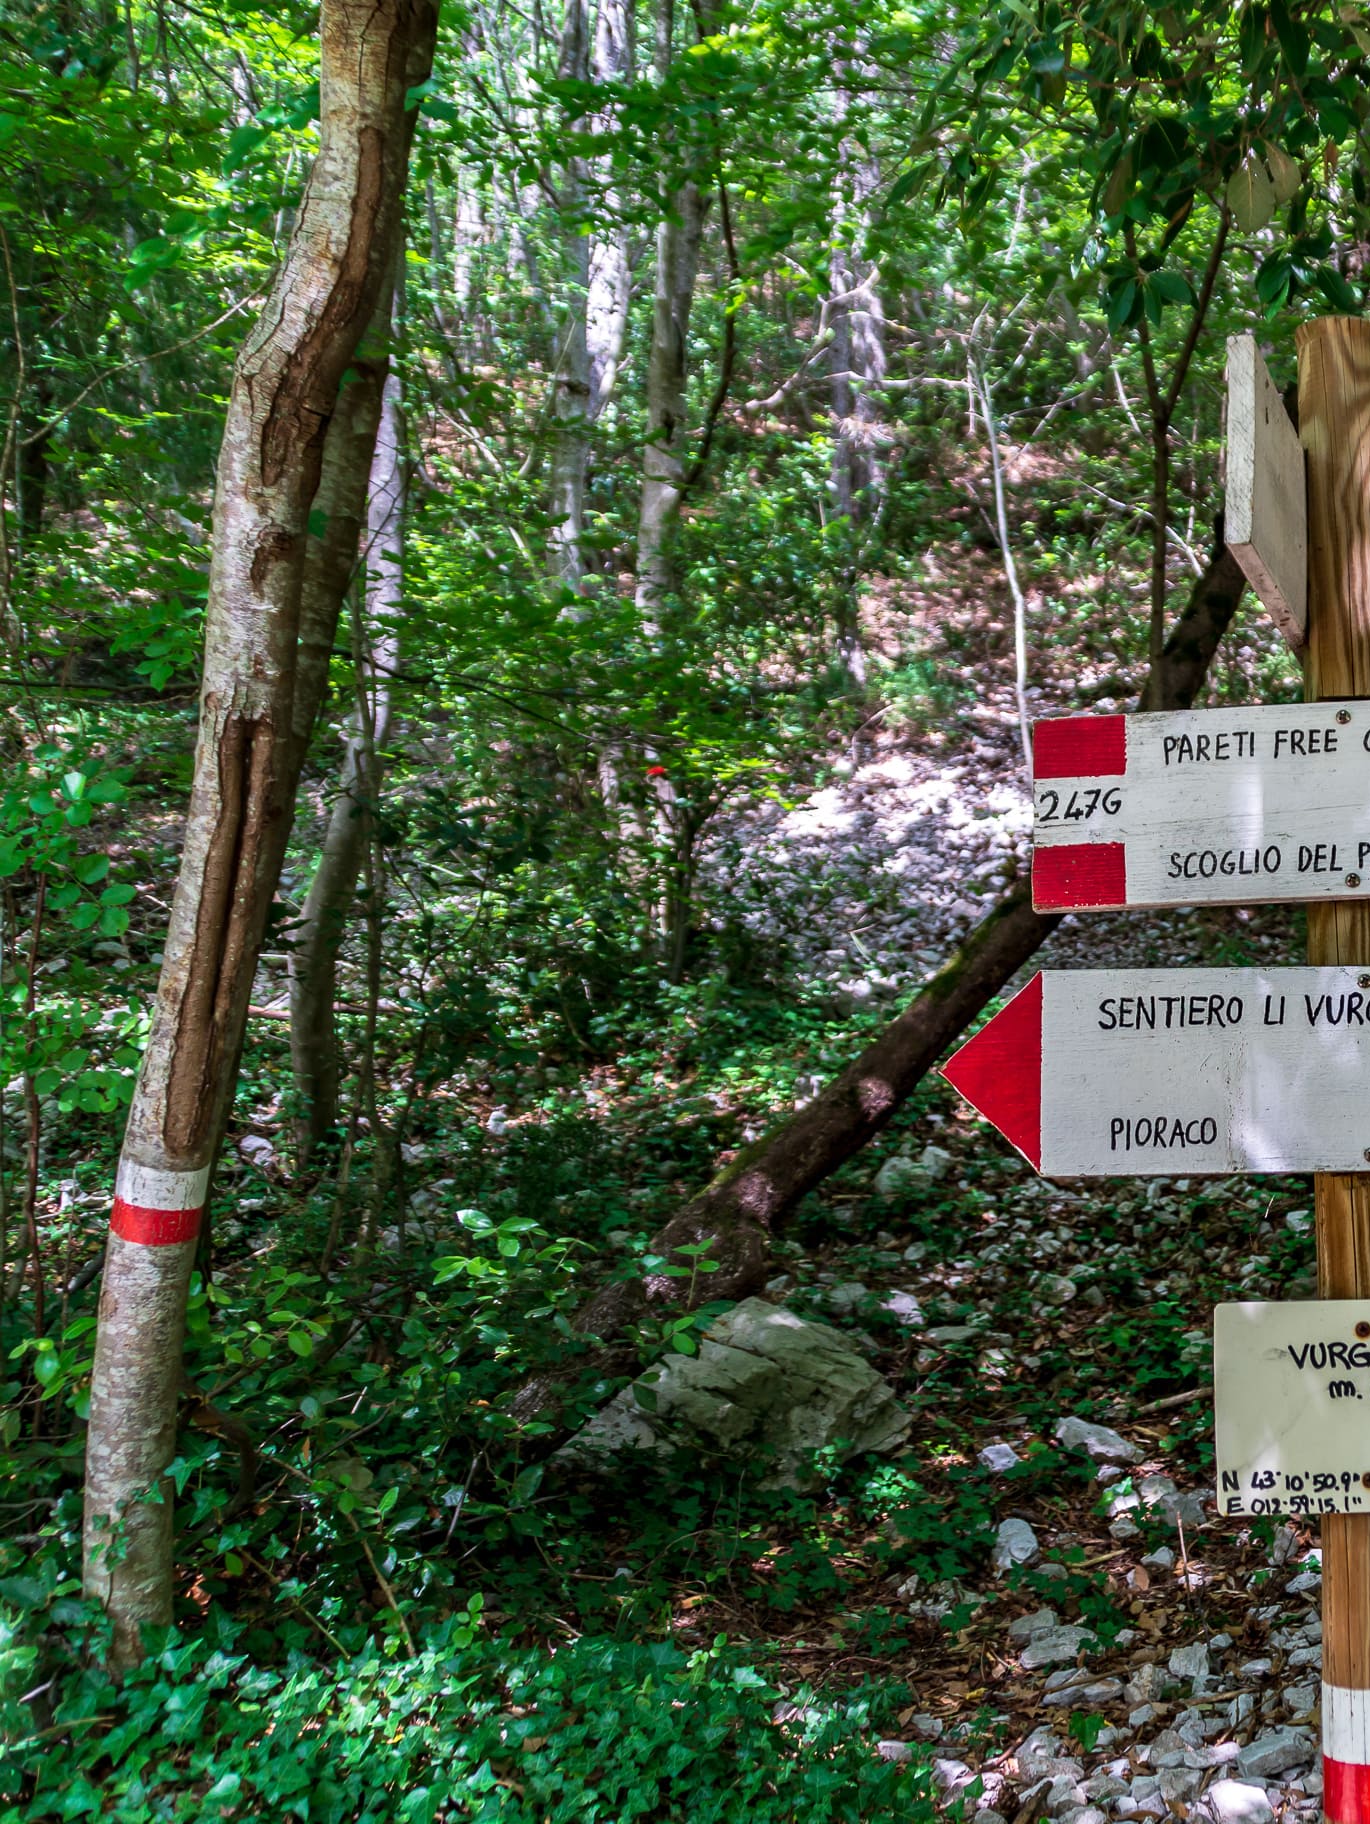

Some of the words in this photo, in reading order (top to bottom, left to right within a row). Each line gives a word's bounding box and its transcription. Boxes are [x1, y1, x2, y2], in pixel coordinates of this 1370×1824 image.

[1163, 731, 1256, 766] PARETI
[1273, 727, 1339, 759] FREE
[1039, 787, 1122, 823] 247G
[1167, 844, 1282, 880] SCOGLIO
[1298, 842, 1344, 873] DEL
[1098, 995, 1244, 1030] SENTIERO
[1264, 995, 1285, 1026] LI
[1110, 1116, 1217, 1151] PIORACO
[1328, 1380, 1363, 1400] m.
[1222, 1470, 1240, 1492] N
[1227, 1497, 1244, 1514] E
